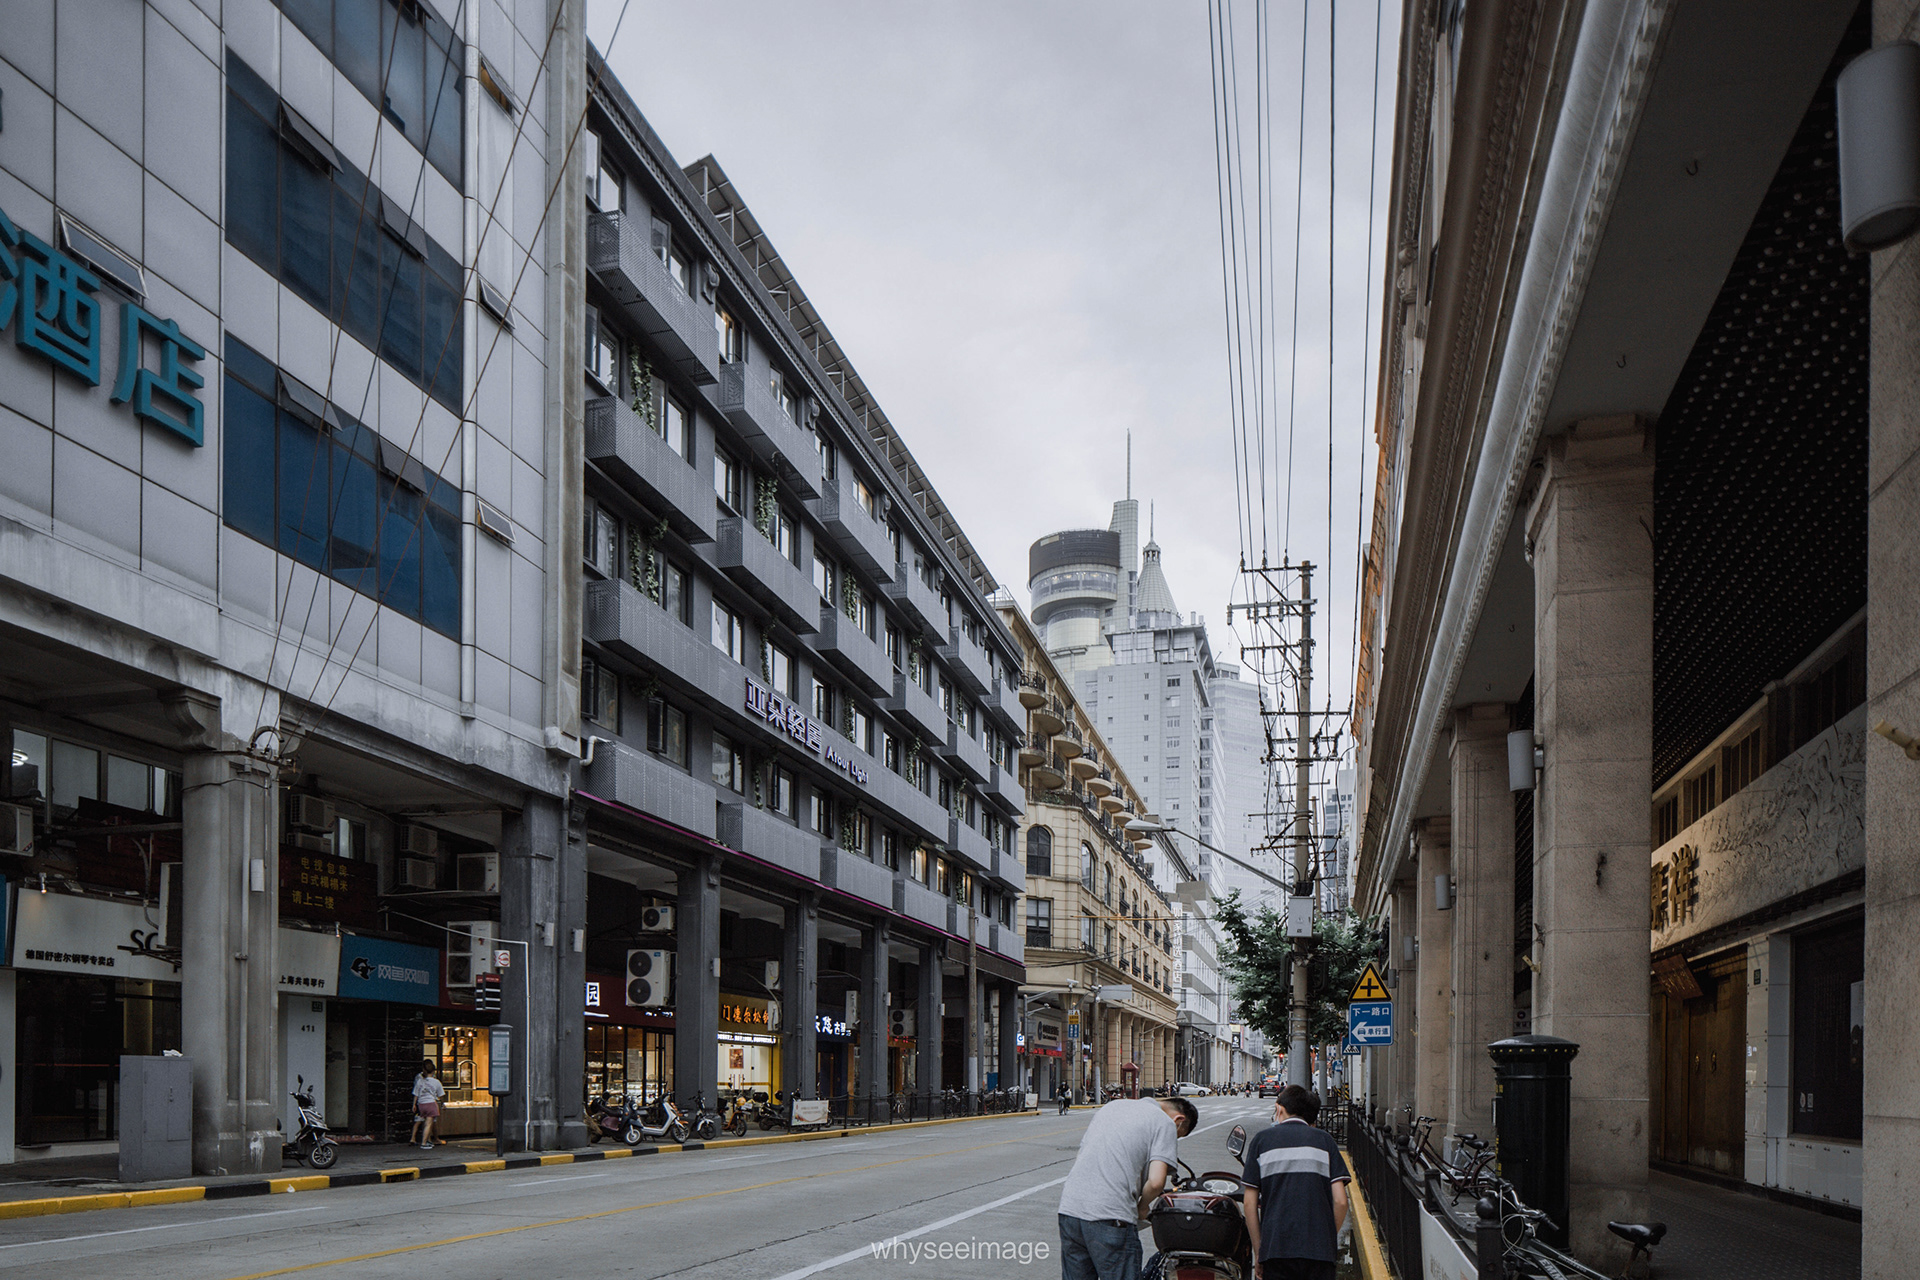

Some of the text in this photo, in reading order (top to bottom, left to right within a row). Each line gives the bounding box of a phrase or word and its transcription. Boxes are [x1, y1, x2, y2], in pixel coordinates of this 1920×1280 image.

[0, 206, 205, 448] 酒店
[745, 677, 822, 754] 亚朵轻居
[825, 746, 869, 784] Atour Light
[300, 872, 349, 893] 日式榻榻米
[292, 889, 335, 910] 请上二楼
[25, 949, 115, 967] 德国舒密尔钢琴专卖店
[377, 964, 430, 985] 网鱼网咖
[1352, 1006, 1389, 1016] 下一路口
[1367, 1027, 1389, 1036] 单行道
